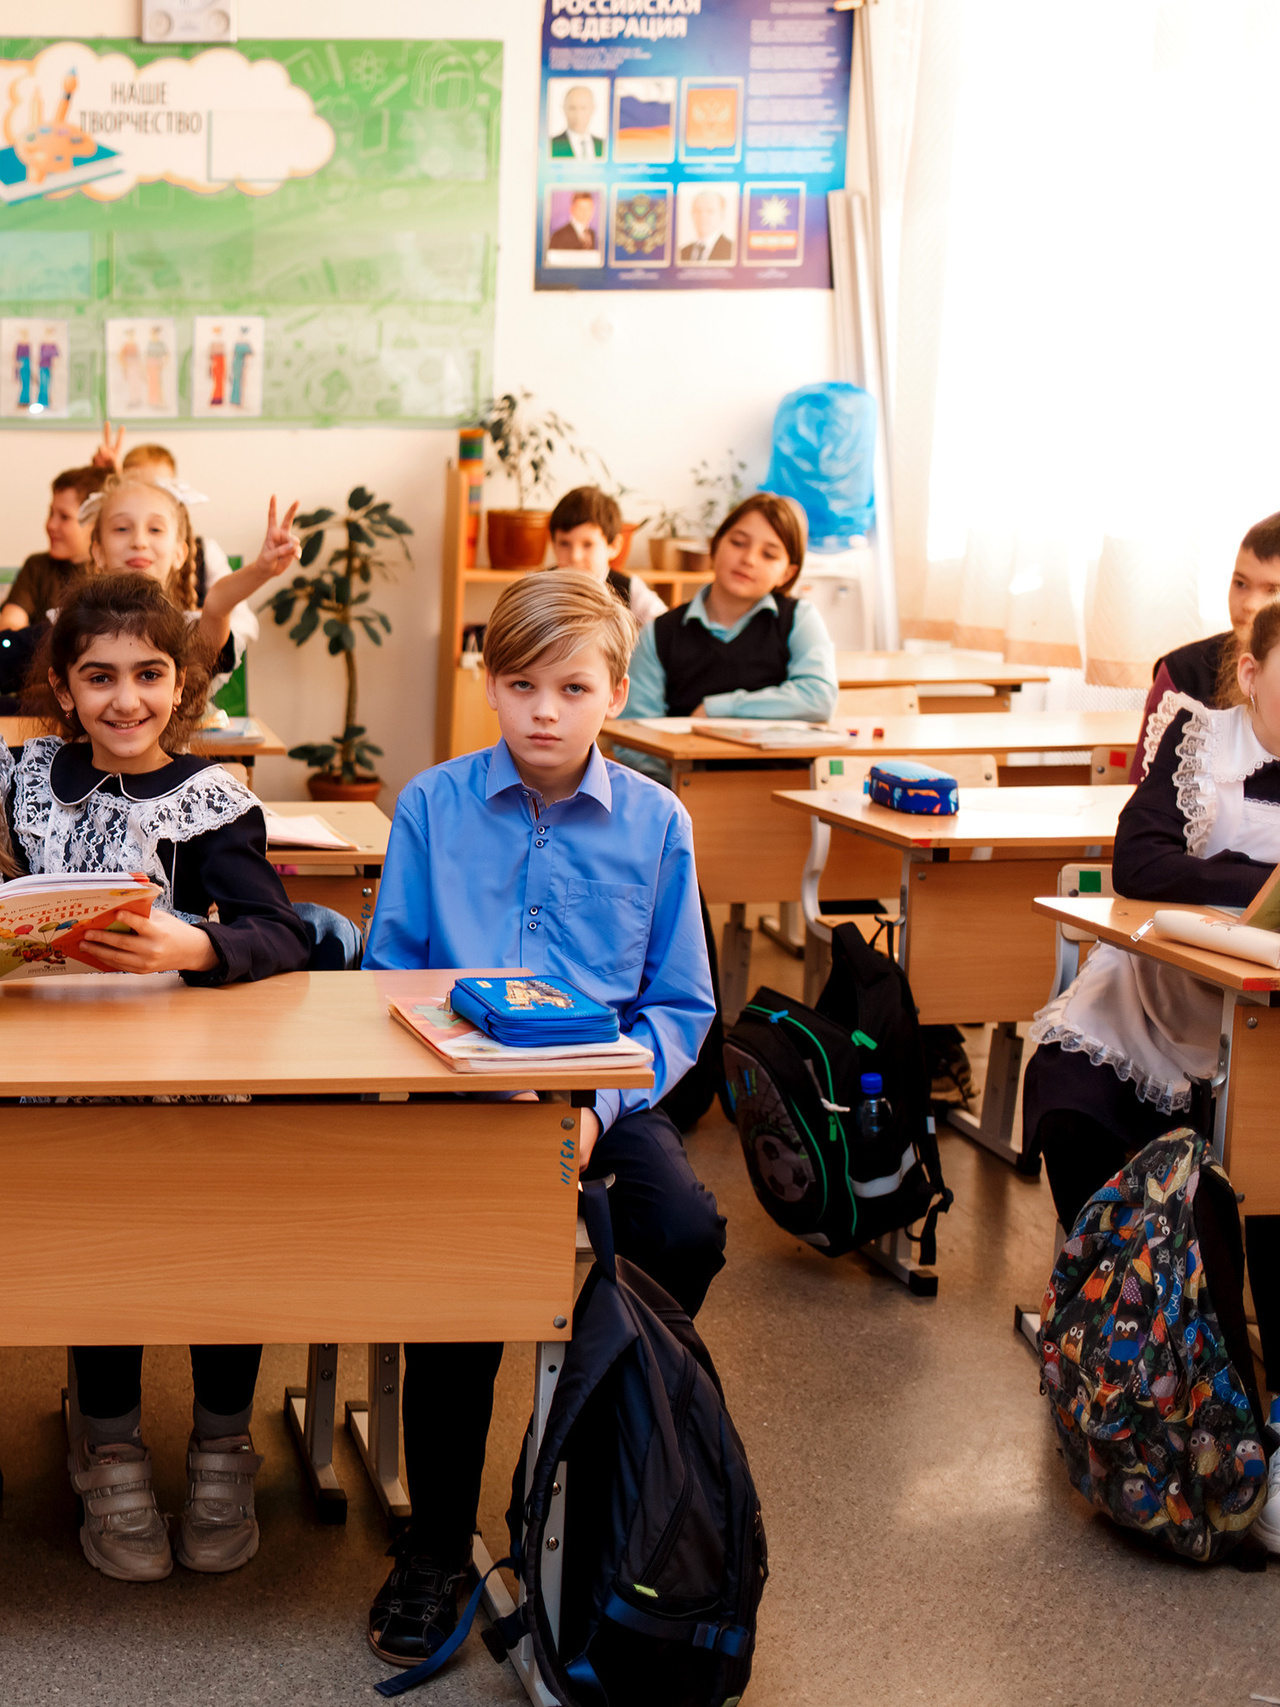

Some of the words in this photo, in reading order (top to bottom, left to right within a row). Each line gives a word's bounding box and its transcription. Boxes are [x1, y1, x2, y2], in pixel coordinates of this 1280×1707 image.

[551, 16, 688, 42] ФЕДЕРАЦИЯ
[110, 82, 168, 105] НАШЕ
[80, 110, 203, 134] ТВОРЧЕСТВО
[560, 1138, 576, 1186] 43/11
